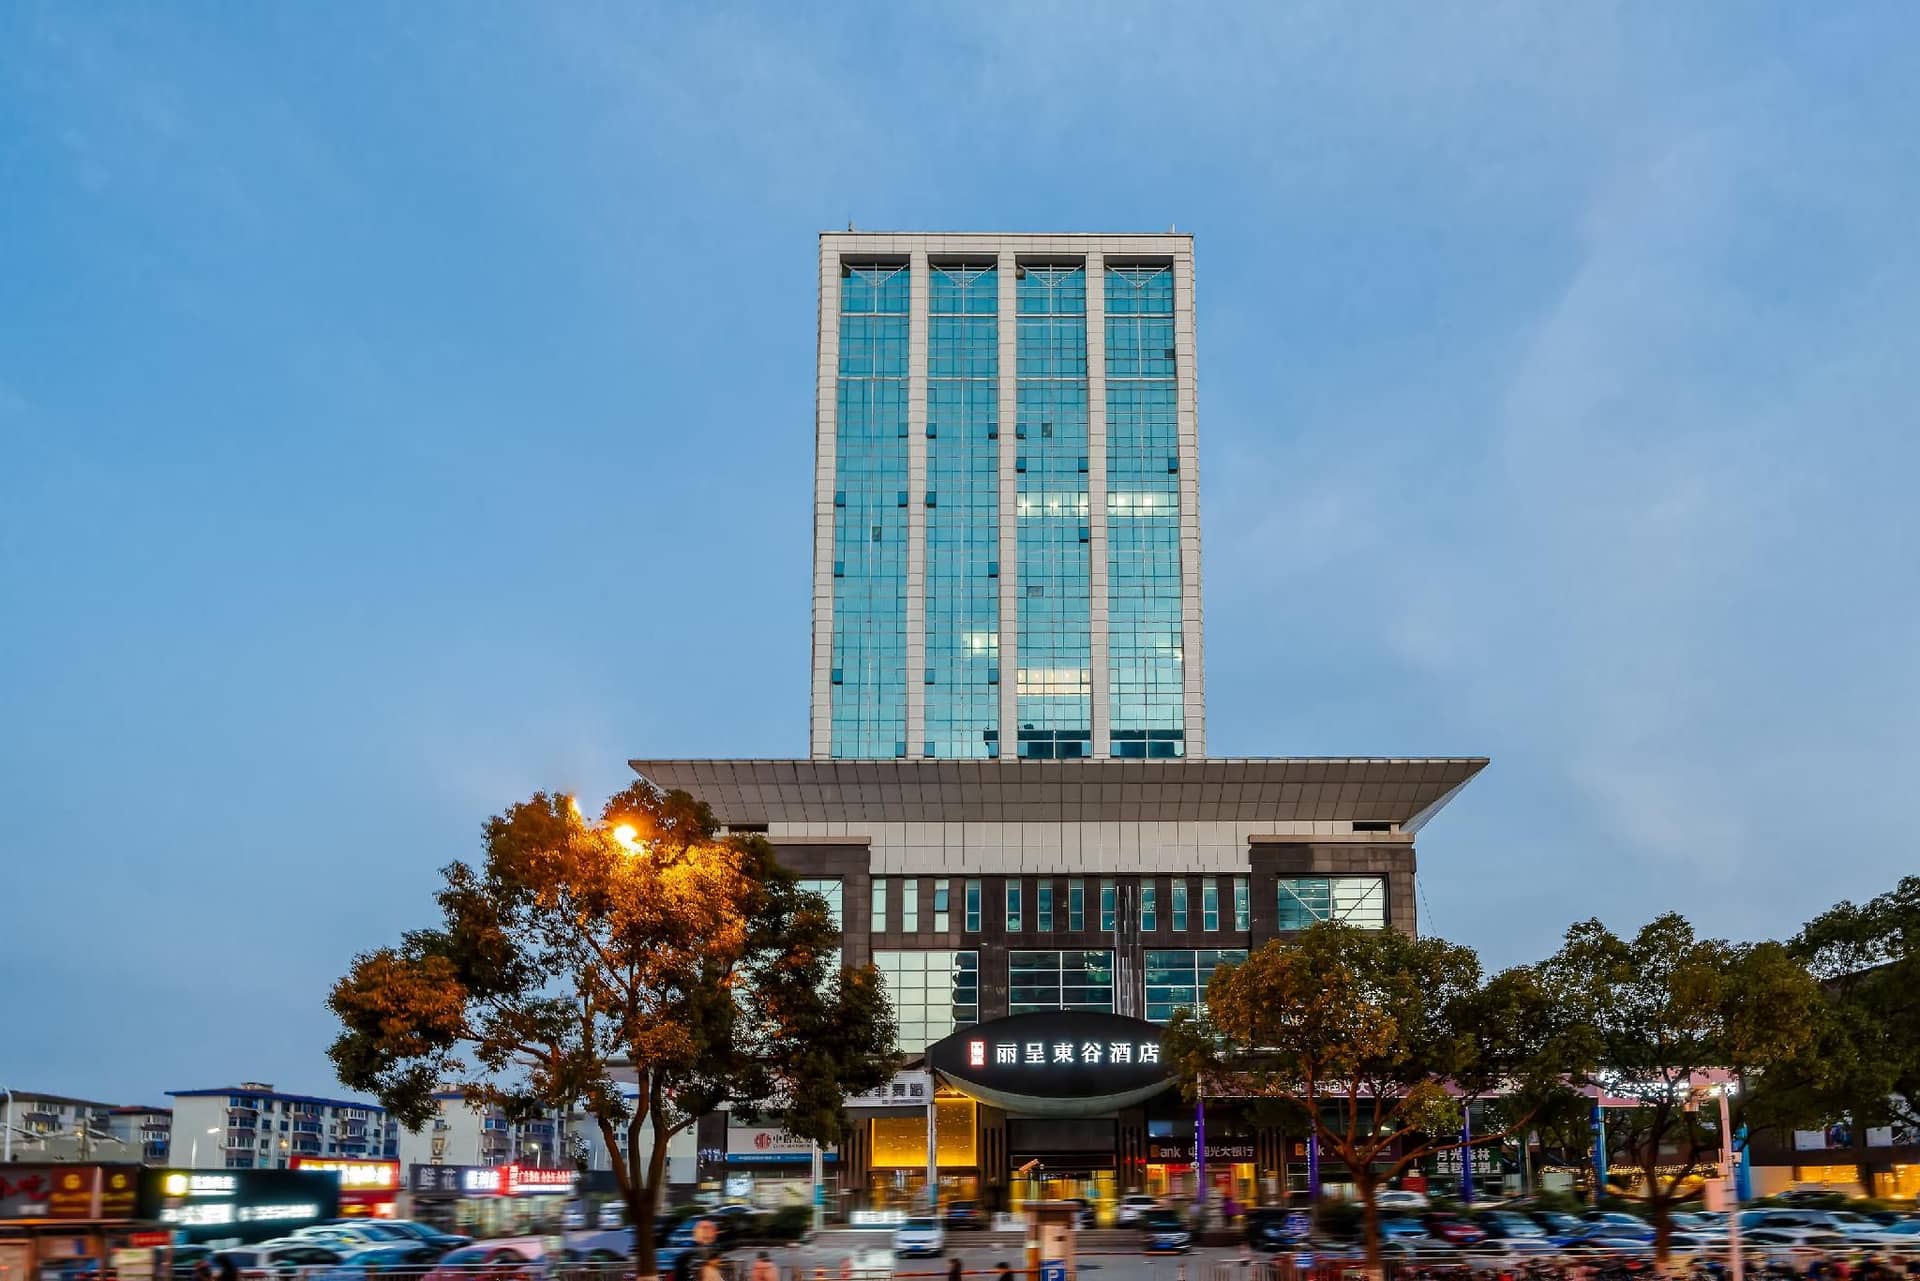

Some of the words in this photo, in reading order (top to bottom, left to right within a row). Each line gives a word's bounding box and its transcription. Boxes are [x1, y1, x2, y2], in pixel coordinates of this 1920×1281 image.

[996, 1042, 1160, 1065] 丽呈東谷酒店
[1313, 1079, 1398, 1097] 中国光大
